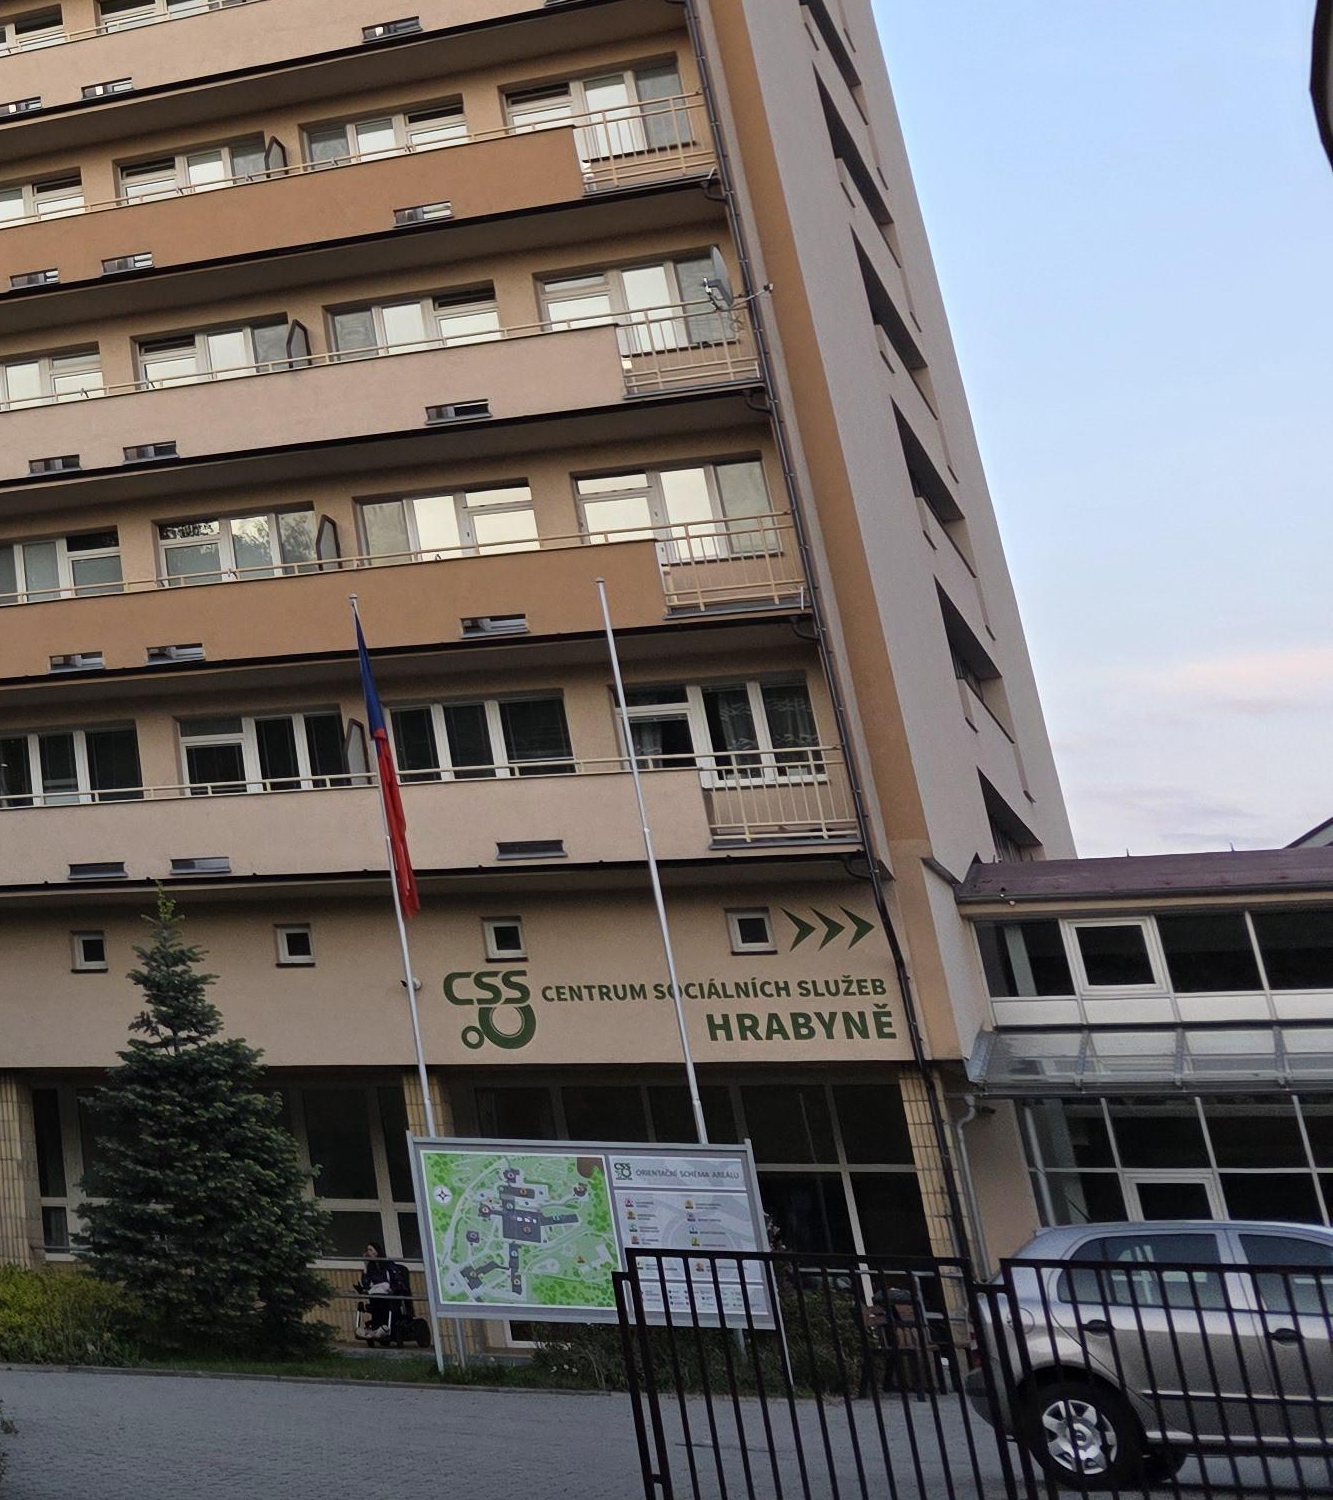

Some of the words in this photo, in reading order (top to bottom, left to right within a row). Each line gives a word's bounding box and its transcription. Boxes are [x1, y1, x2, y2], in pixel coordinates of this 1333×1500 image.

[443, 970, 531, 1006] CSS
[541, 983, 647, 1002] CENTRUM
[653, 976, 791, 1000] SOCIÁLNÍCH
[797, 974, 887, 997] SLUŽEB
[706, 1003, 897, 1042] HRABYNĚ
